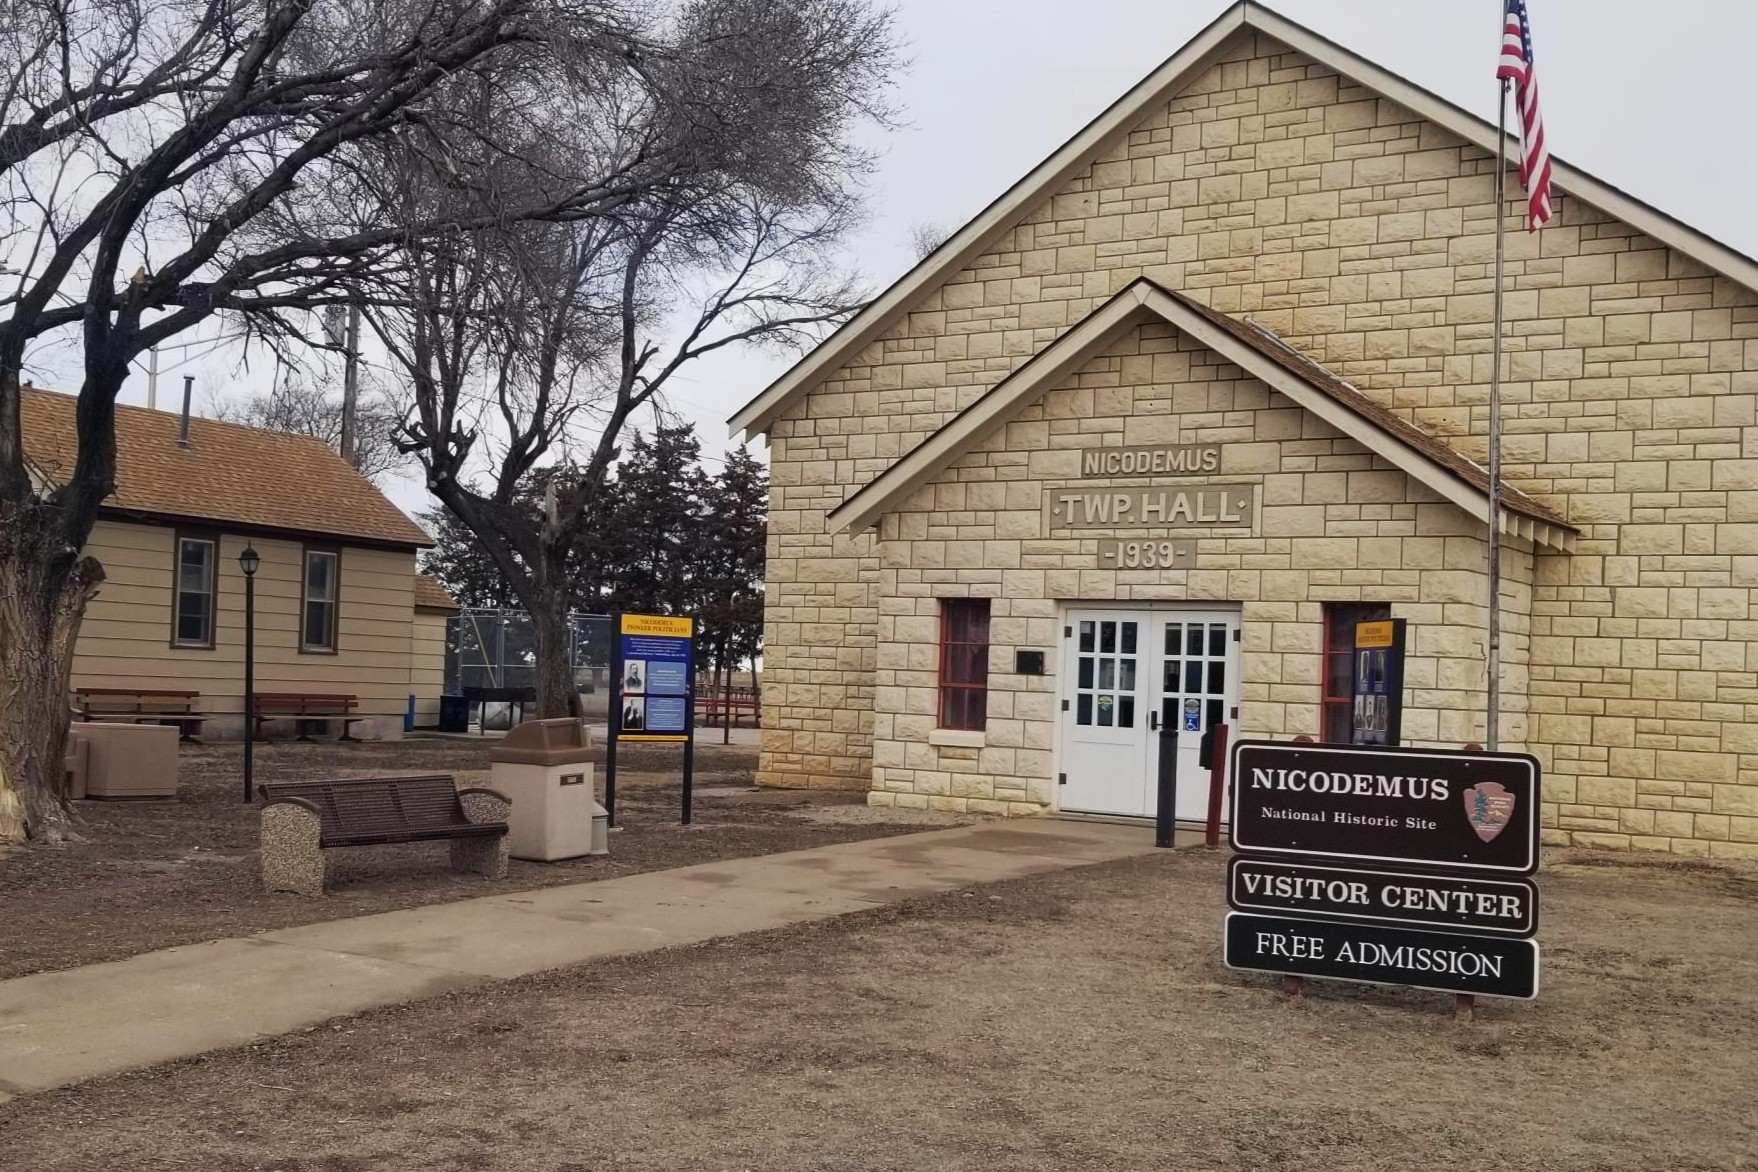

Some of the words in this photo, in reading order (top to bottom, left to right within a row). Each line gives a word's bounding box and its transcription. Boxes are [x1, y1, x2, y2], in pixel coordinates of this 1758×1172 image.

[1084, 449, 1217, 474] NICODEMUS
[1141, 491, 1241, 523] HALL
[1251, 767, 1450, 801] NICODEMUS
[1261, 806, 1326, 822] National
[1334, 811, 1399, 828] Historic
[1405, 816, 1437, 830] Site
[1241, 872, 1370, 905] VISITOR
[1381, 885, 1523, 919] CENTER
[1256, 932, 1325, 960] FREE
[1334, 940, 1504, 978] ADMISSION
